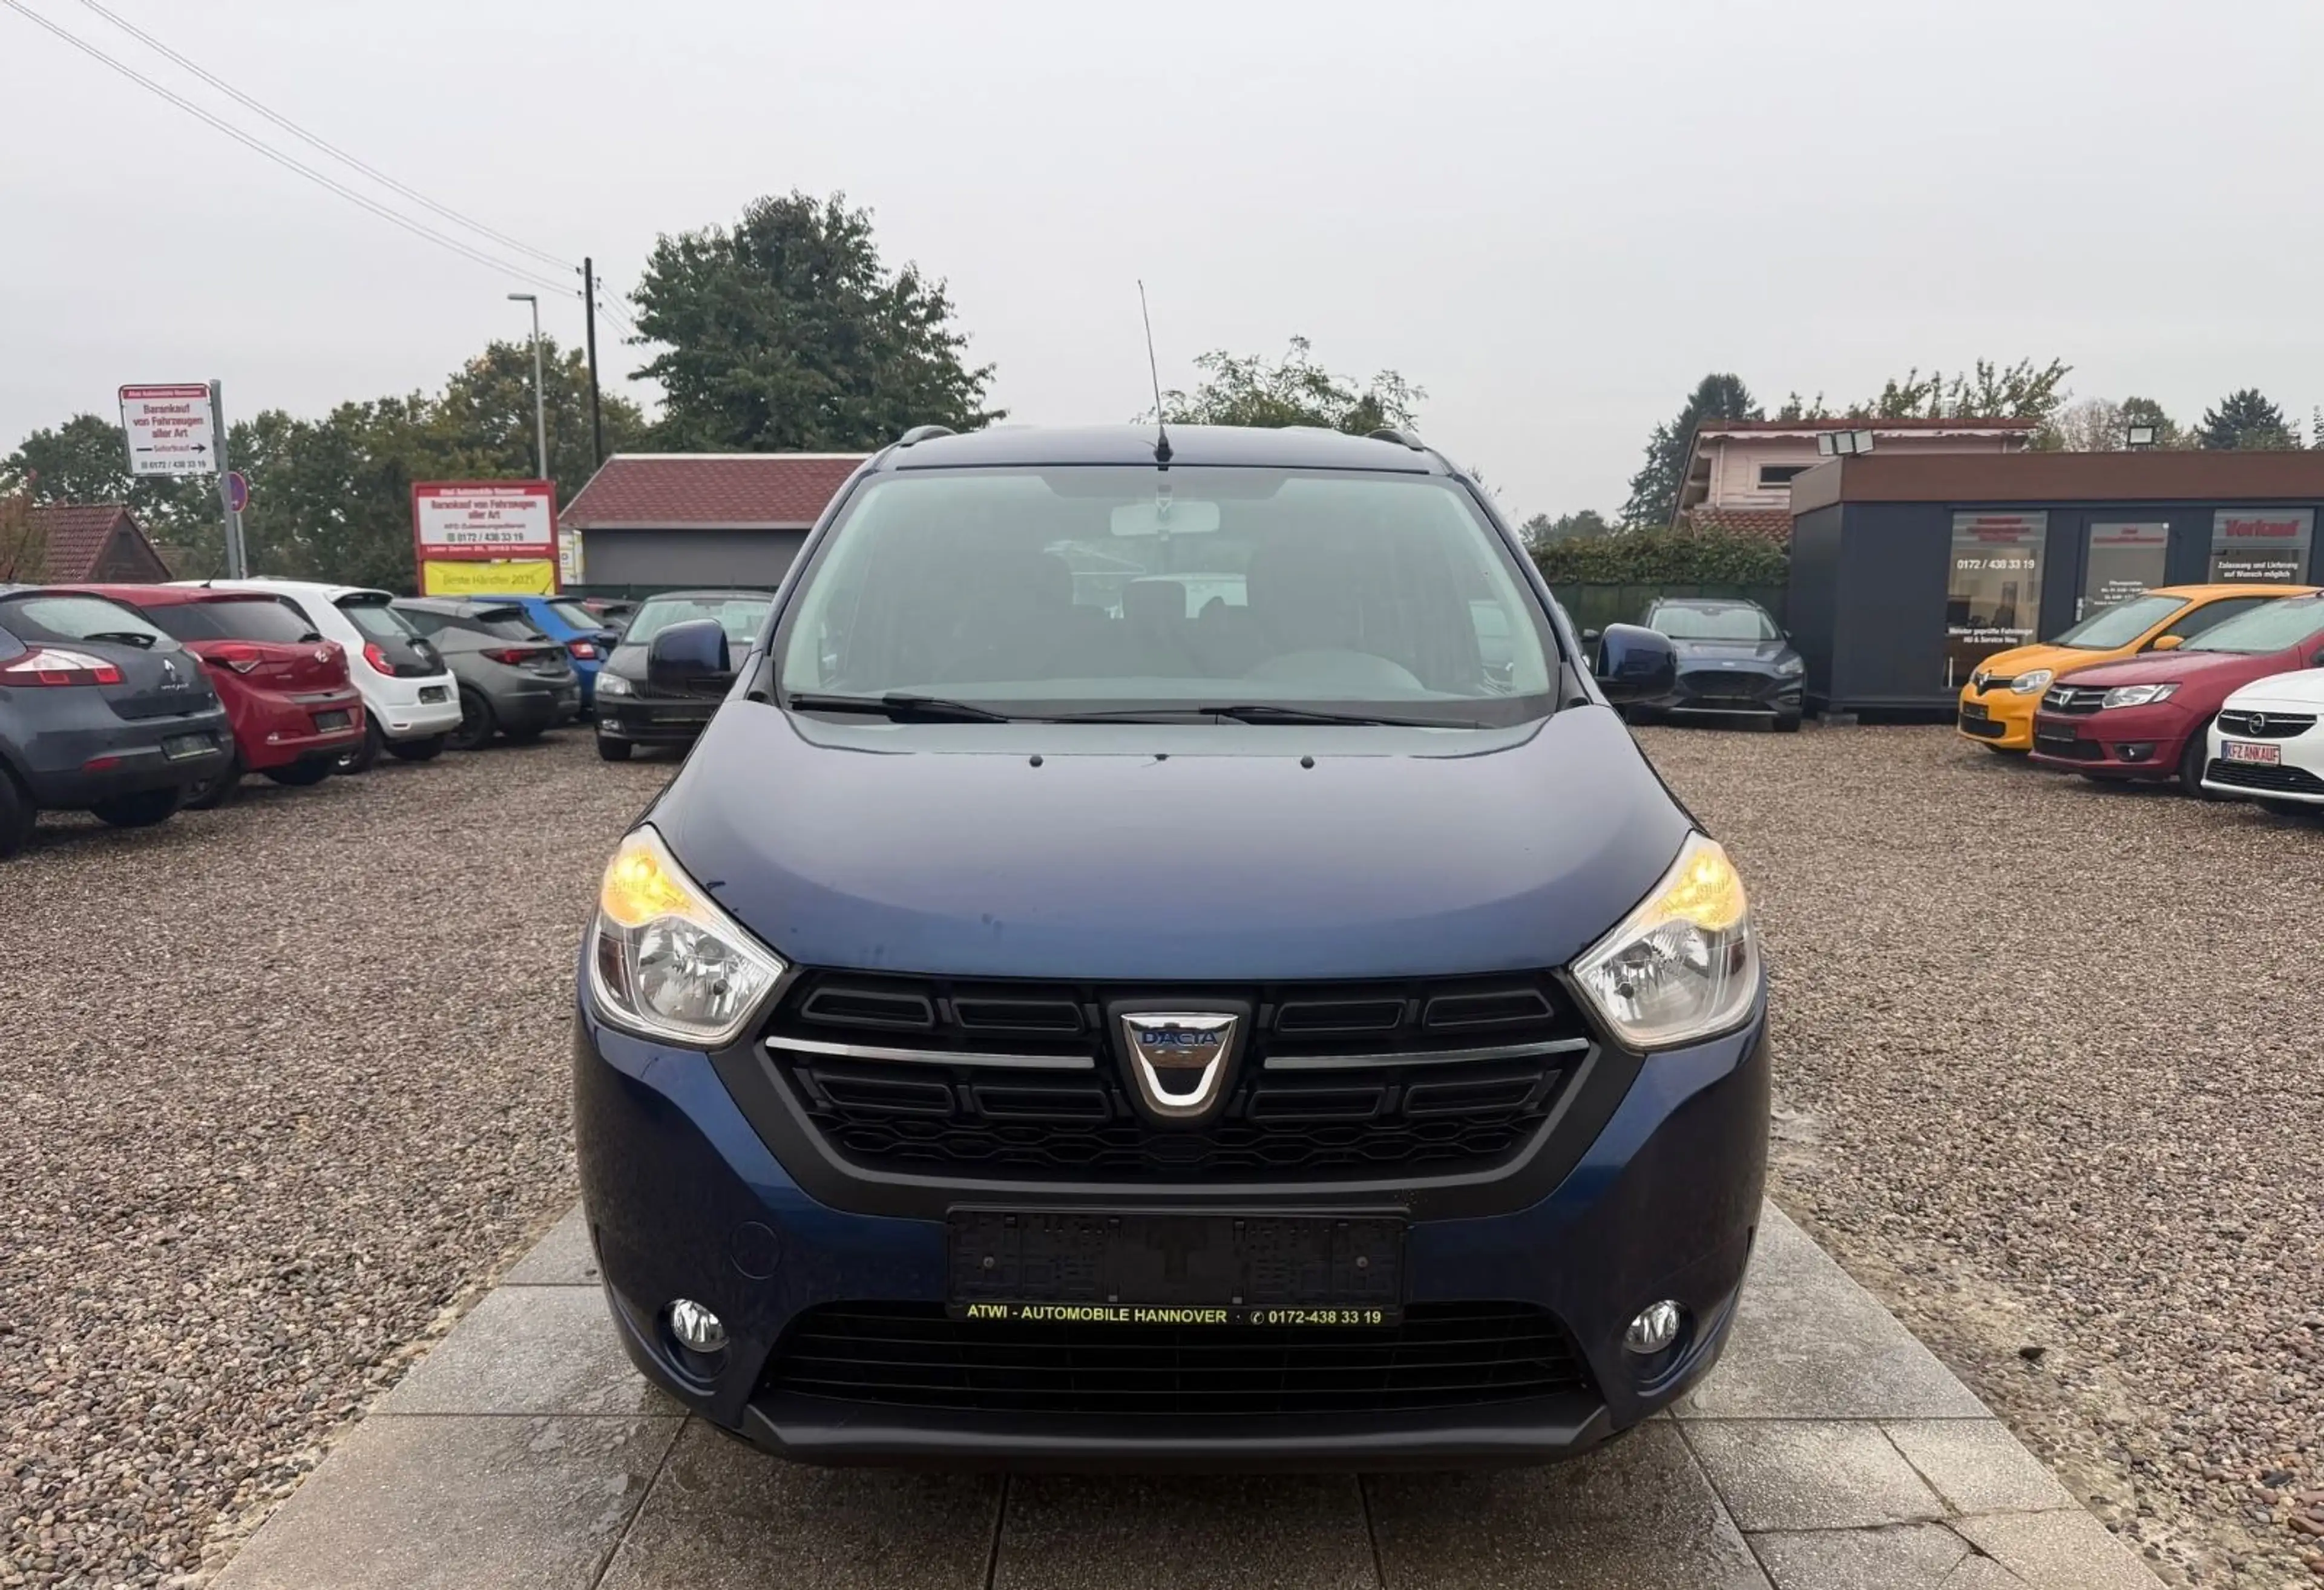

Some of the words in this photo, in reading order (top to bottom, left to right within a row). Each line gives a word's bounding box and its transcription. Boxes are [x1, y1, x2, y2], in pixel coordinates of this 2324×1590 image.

[153, 416, 204, 427] Fahrzeugen
[153, 429, 171, 438] aller
[174, 428, 188, 437] Art
[488, 511, 500, 519] Art
[2225, 519, 2300, 537] Verkauf
[458, 533, 477, 541] 0172
[1957, 559, 1981, 569] 0172
[1989, 559, 2007, 569] 438
[2009, 559, 2021, 569] 33
[2023, 559, 2035, 569] 19
[2227, 744, 2242, 759] KFZ
[2244, 745, 2279, 761] ANKAUF
[1141, 1031, 1218, 1045] DACIA
[967, 1304, 1008, 1318] ATWI
[1021, 1306, 1130, 1321] AUTOMOBILE
[1135, 1309, 1227, 1323] HANNOVER
[1269, 1310, 1336, 1324] 0172-438
[1341, 1310, 1359, 1324] 33
[1364, 1310, 1381, 1324] 19
